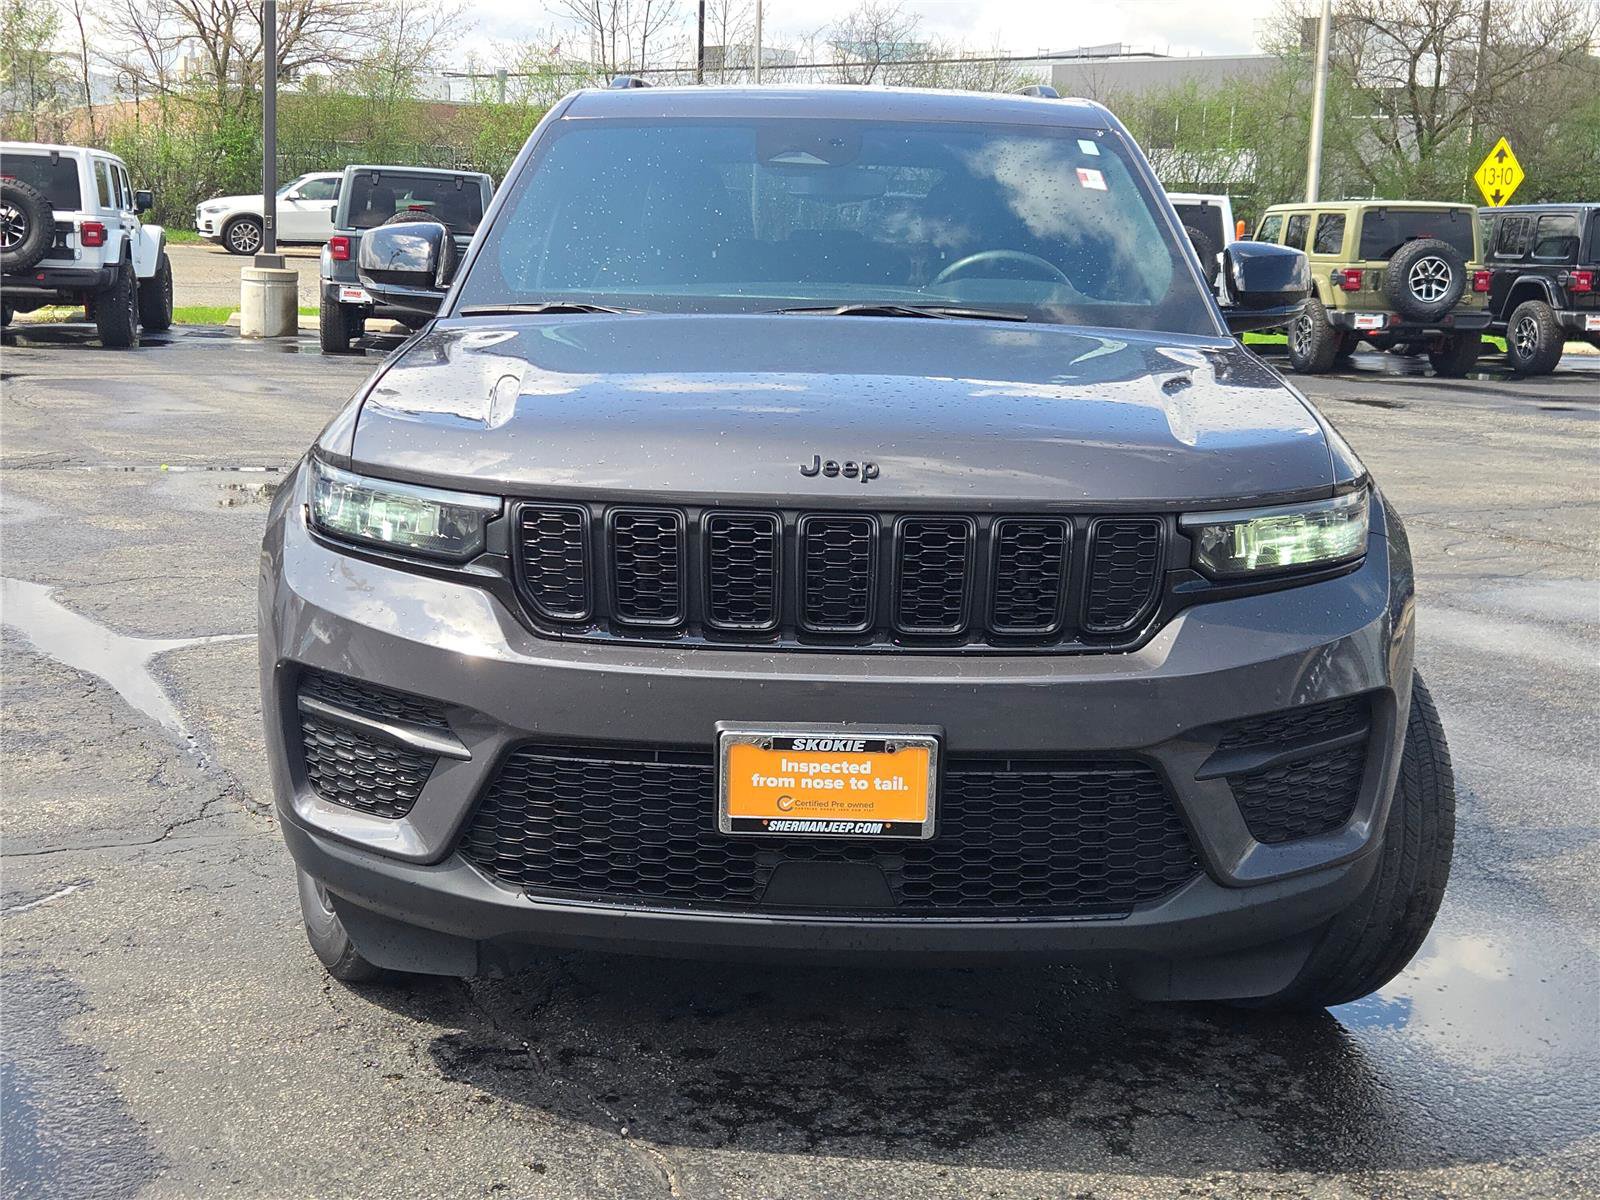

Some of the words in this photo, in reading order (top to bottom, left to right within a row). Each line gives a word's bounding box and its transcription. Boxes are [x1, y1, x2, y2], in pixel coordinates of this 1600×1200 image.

[1483, 168, 1513, 185] 13-10
[799, 455, 880, 484] Jeep
[792, 738, 866, 752] SKOKIE
[781, 759, 871, 776] Inspected
[752, 774, 795, 787] from
[801, 777, 844, 789] nose
[850, 776, 868, 789] to
[874, 776, 908, 790] tail.
[795, 800, 829, 808] Certified
[768, 820, 883, 834] SHERMANJEEP.COM
